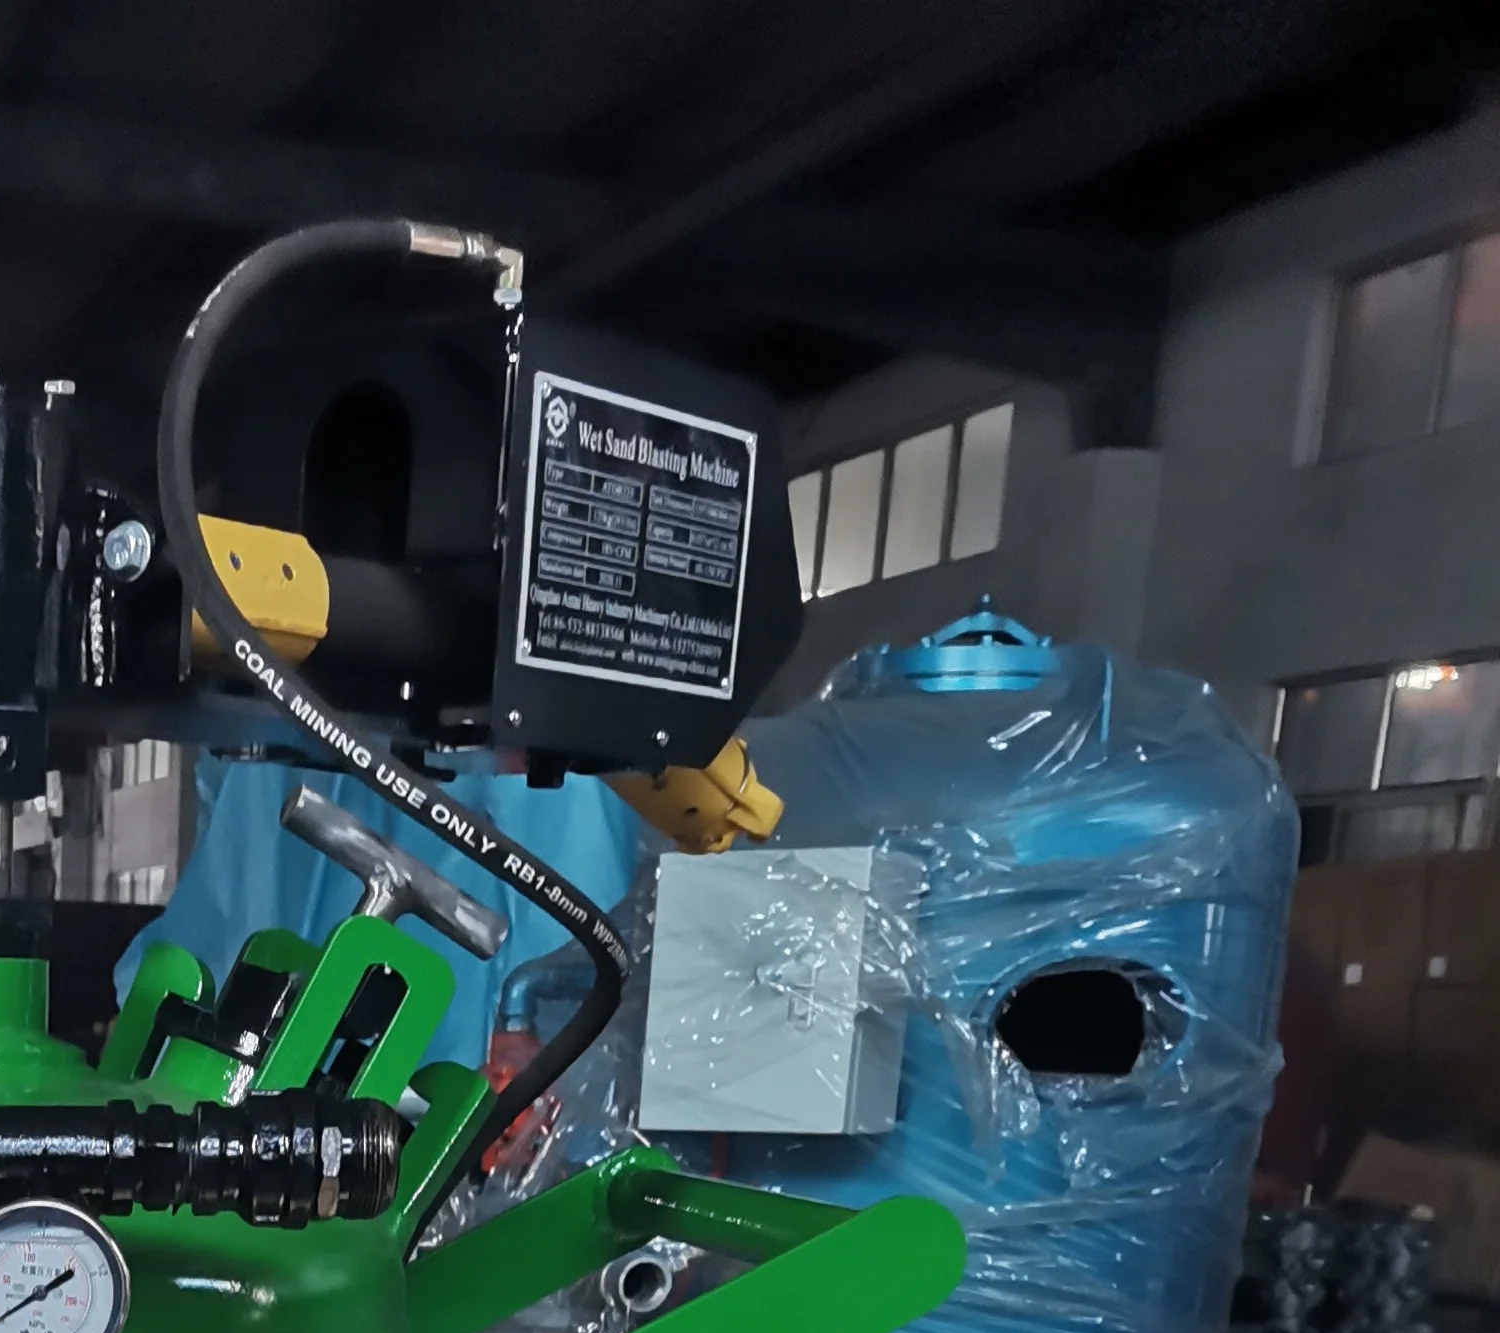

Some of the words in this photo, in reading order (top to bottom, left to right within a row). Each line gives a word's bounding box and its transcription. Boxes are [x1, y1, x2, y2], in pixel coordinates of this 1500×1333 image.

[578, 420, 602, 451] Wet
[605, 428, 635, 460] Sand
[638, 436, 687, 480] Blasting
[690, 449, 739, 487] Machine
[234, 638, 286, 702] COAL
[289, 694, 373, 769] MINING
[374, 763, 427, 809] USE
[430, 804, 498, 857] ONLY
[502, 852, 589, 925] RB1-8mm
